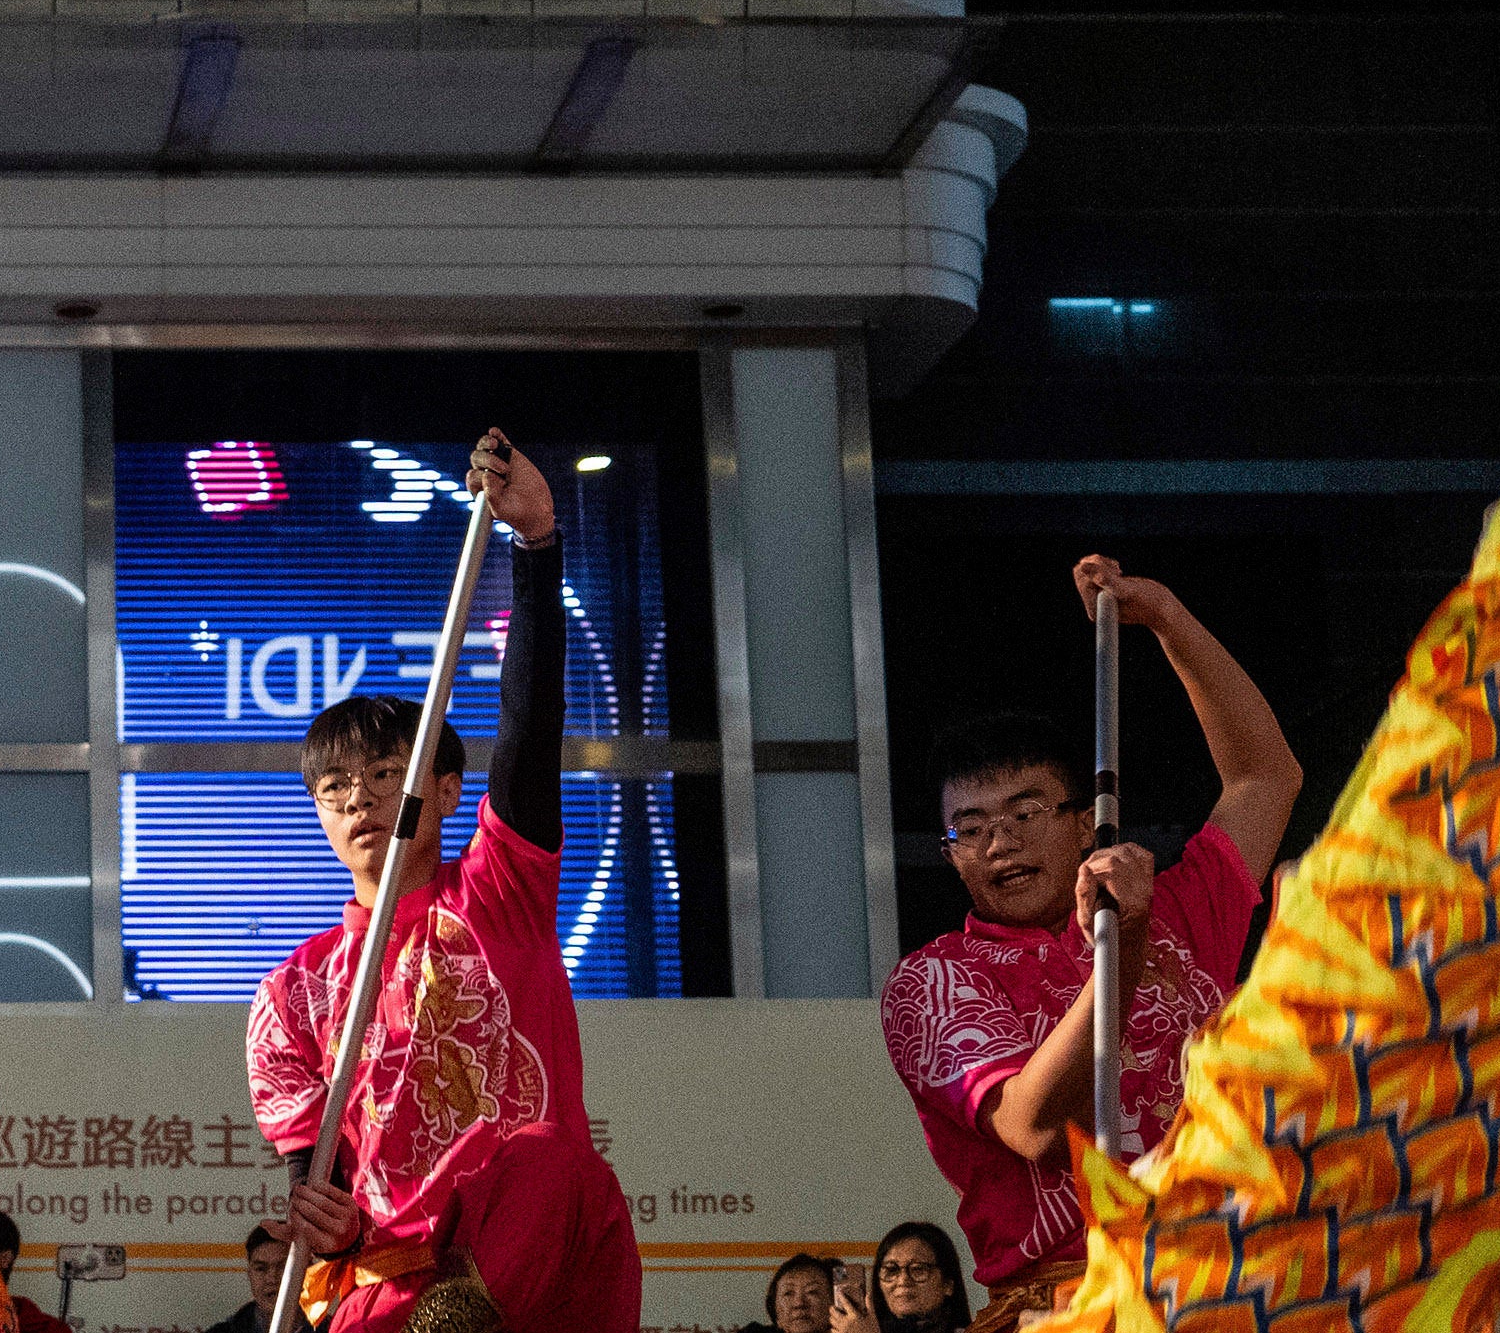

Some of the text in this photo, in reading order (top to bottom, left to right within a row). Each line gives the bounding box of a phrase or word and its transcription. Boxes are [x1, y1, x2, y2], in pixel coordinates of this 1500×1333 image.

[102, 1183, 152, 1215] the
[167, 1183, 288, 1223] parade
[670, 1184, 755, 1215] times
